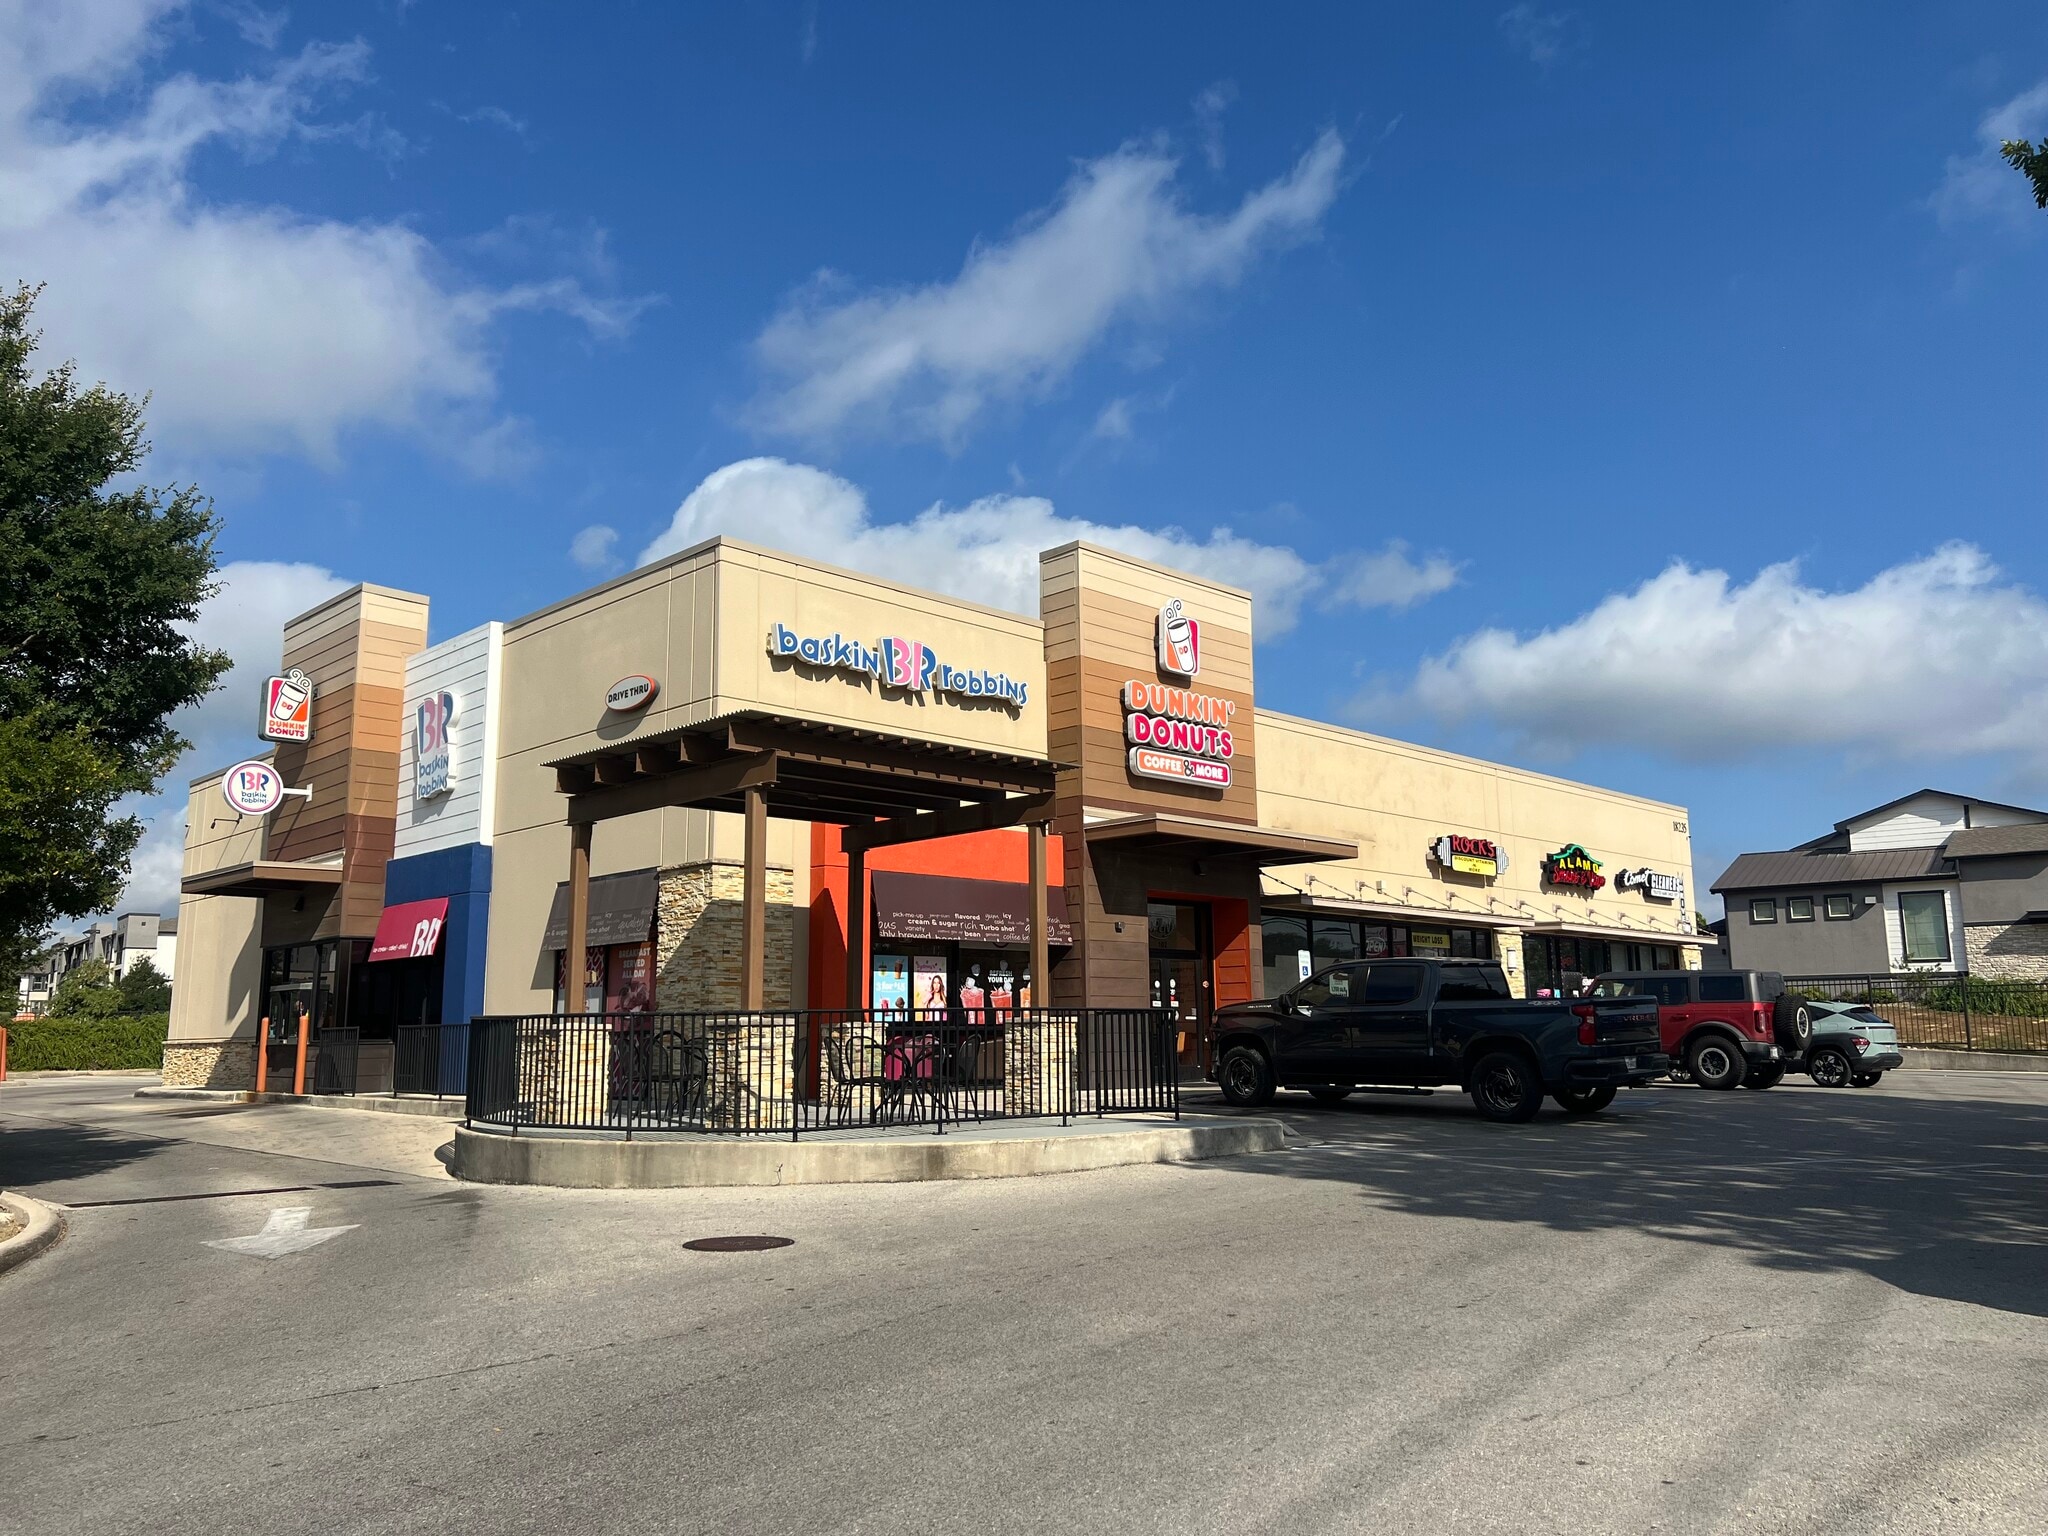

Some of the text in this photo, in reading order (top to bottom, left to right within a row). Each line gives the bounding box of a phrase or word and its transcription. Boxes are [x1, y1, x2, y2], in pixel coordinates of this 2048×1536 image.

[776, 622, 1028, 705] baskin BR robbins
[607, 683, 650, 703] DRIVE THRU
[281, 700, 293, 710] DD
[1130, 680, 1236, 725] DUNKIN'
[417, 690, 454, 754] BR
[268, 726, 305, 738] DONUTS
[1133, 713, 1233, 758] DONUTS
[419, 754, 448, 778] baskin
[1143, 753, 1225, 781] COFFEE & MORE
[240, 771, 269, 791] BR
[417, 773, 447, 799] robbins
[240, 790, 267, 799] baskin
[1559, 856, 1600, 875] ALAMO
[1623, 869, 1650, 888] Comet
[954, 913, 981, 921] flavored
[938, 920, 959, 928] sugar
[960, 920, 978, 930] rich
[979, 923, 999, 931] Turbo
[1412, 935, 1443, 945] WEIGHT LOSS
[618, 947, 651, 959] BREAKFAST
[623, 958, 645, 968] SERVED
[622, 969, 646, 979] ALL DAY
[987, 976, 1015, 984] YOUR DAY
